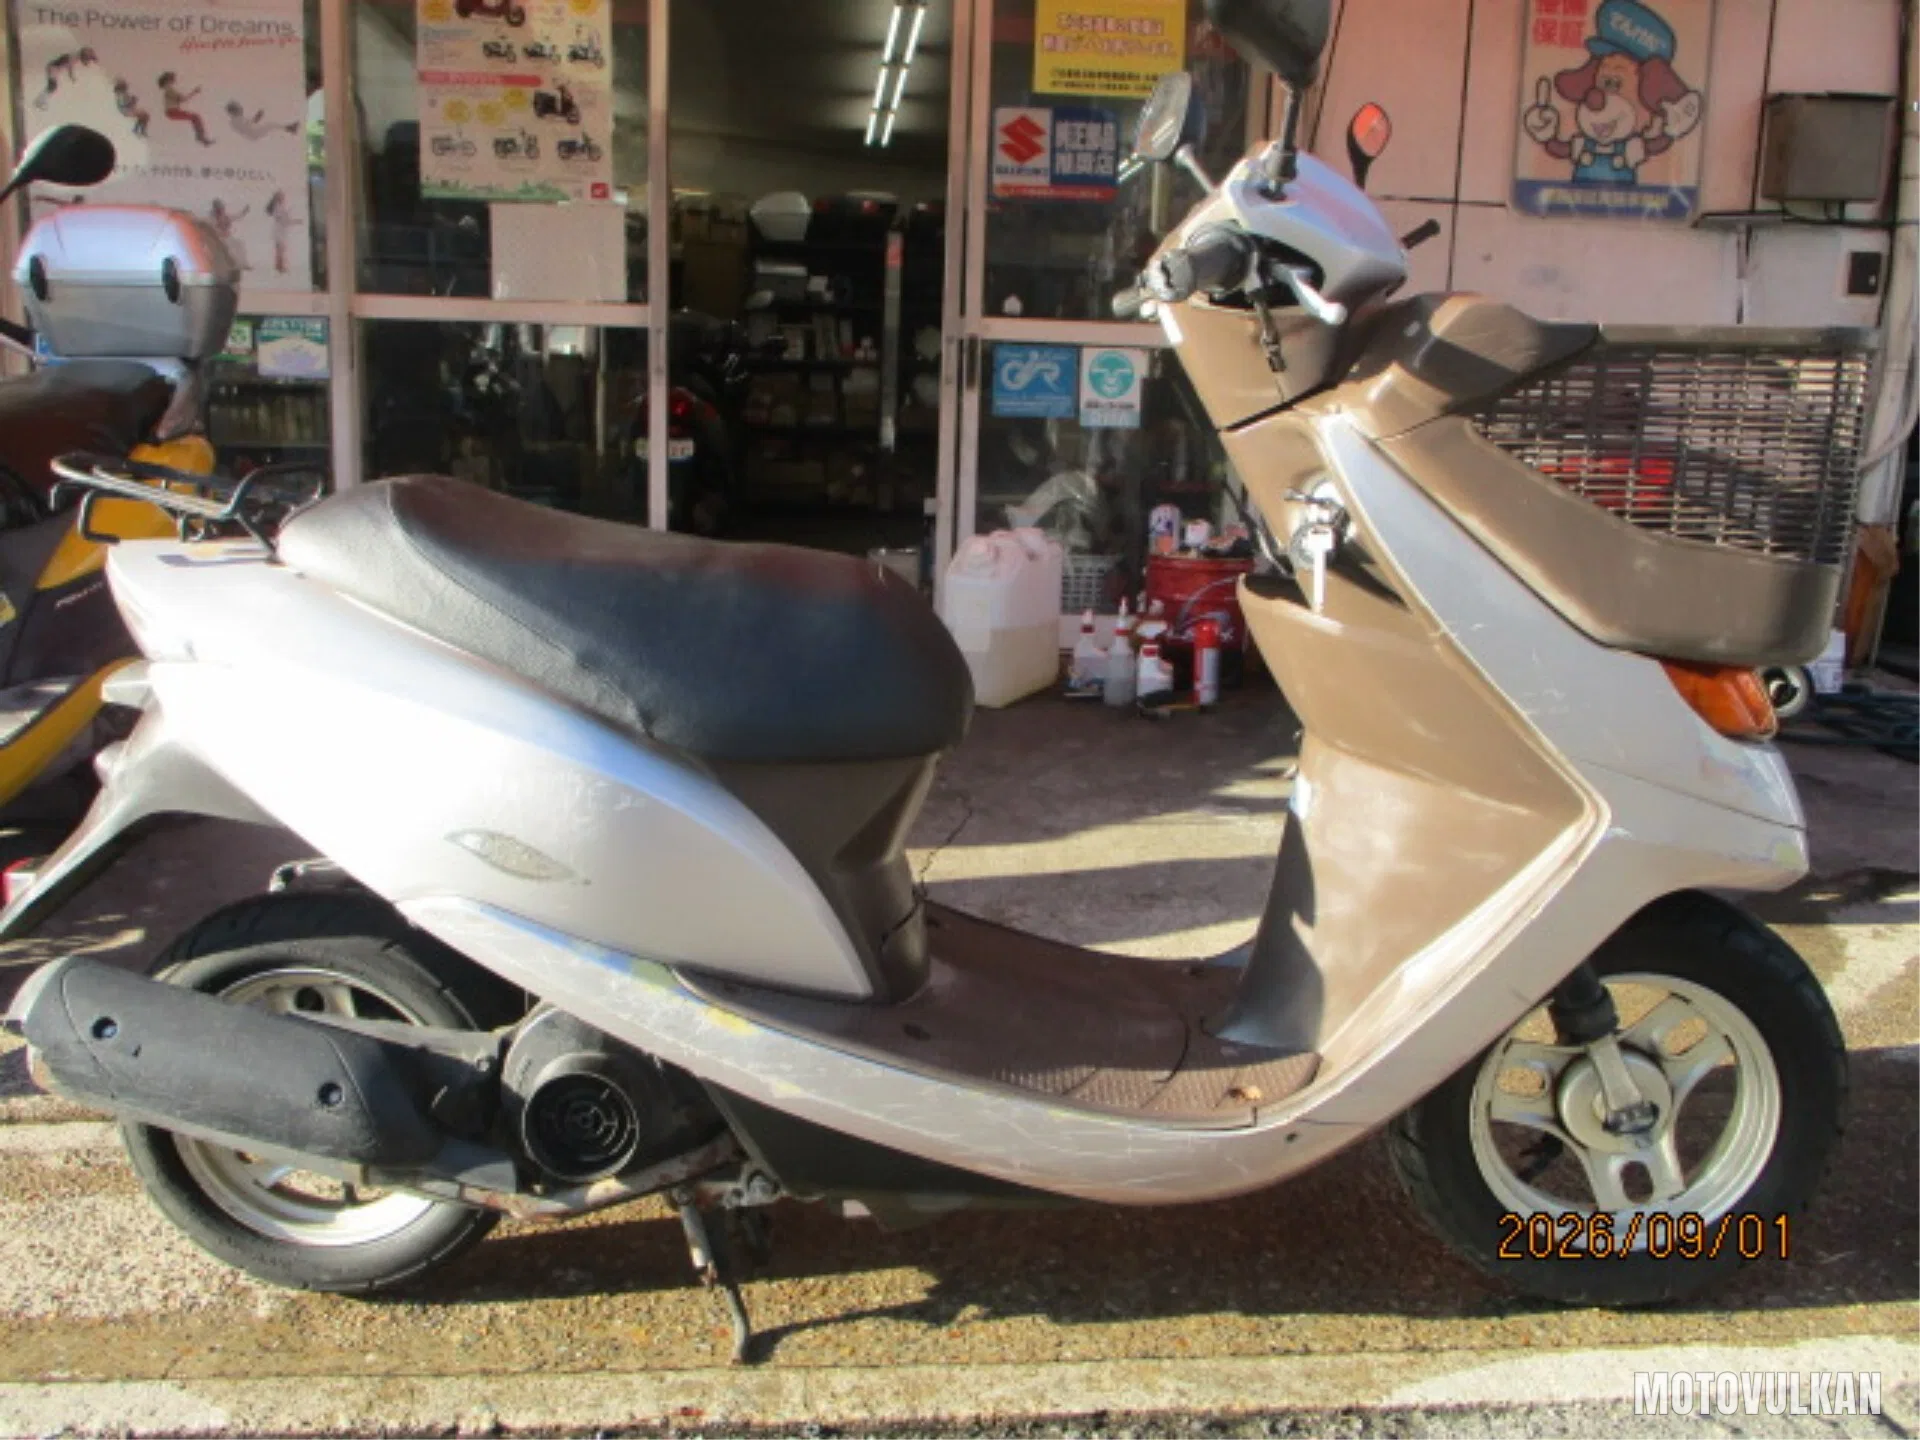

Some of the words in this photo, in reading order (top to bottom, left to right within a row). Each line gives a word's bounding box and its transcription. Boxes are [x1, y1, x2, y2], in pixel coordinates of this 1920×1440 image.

[35, 8, 80, 27] The
[84, 9, 163, 31] Power
[167, 14, 196, 33] of
